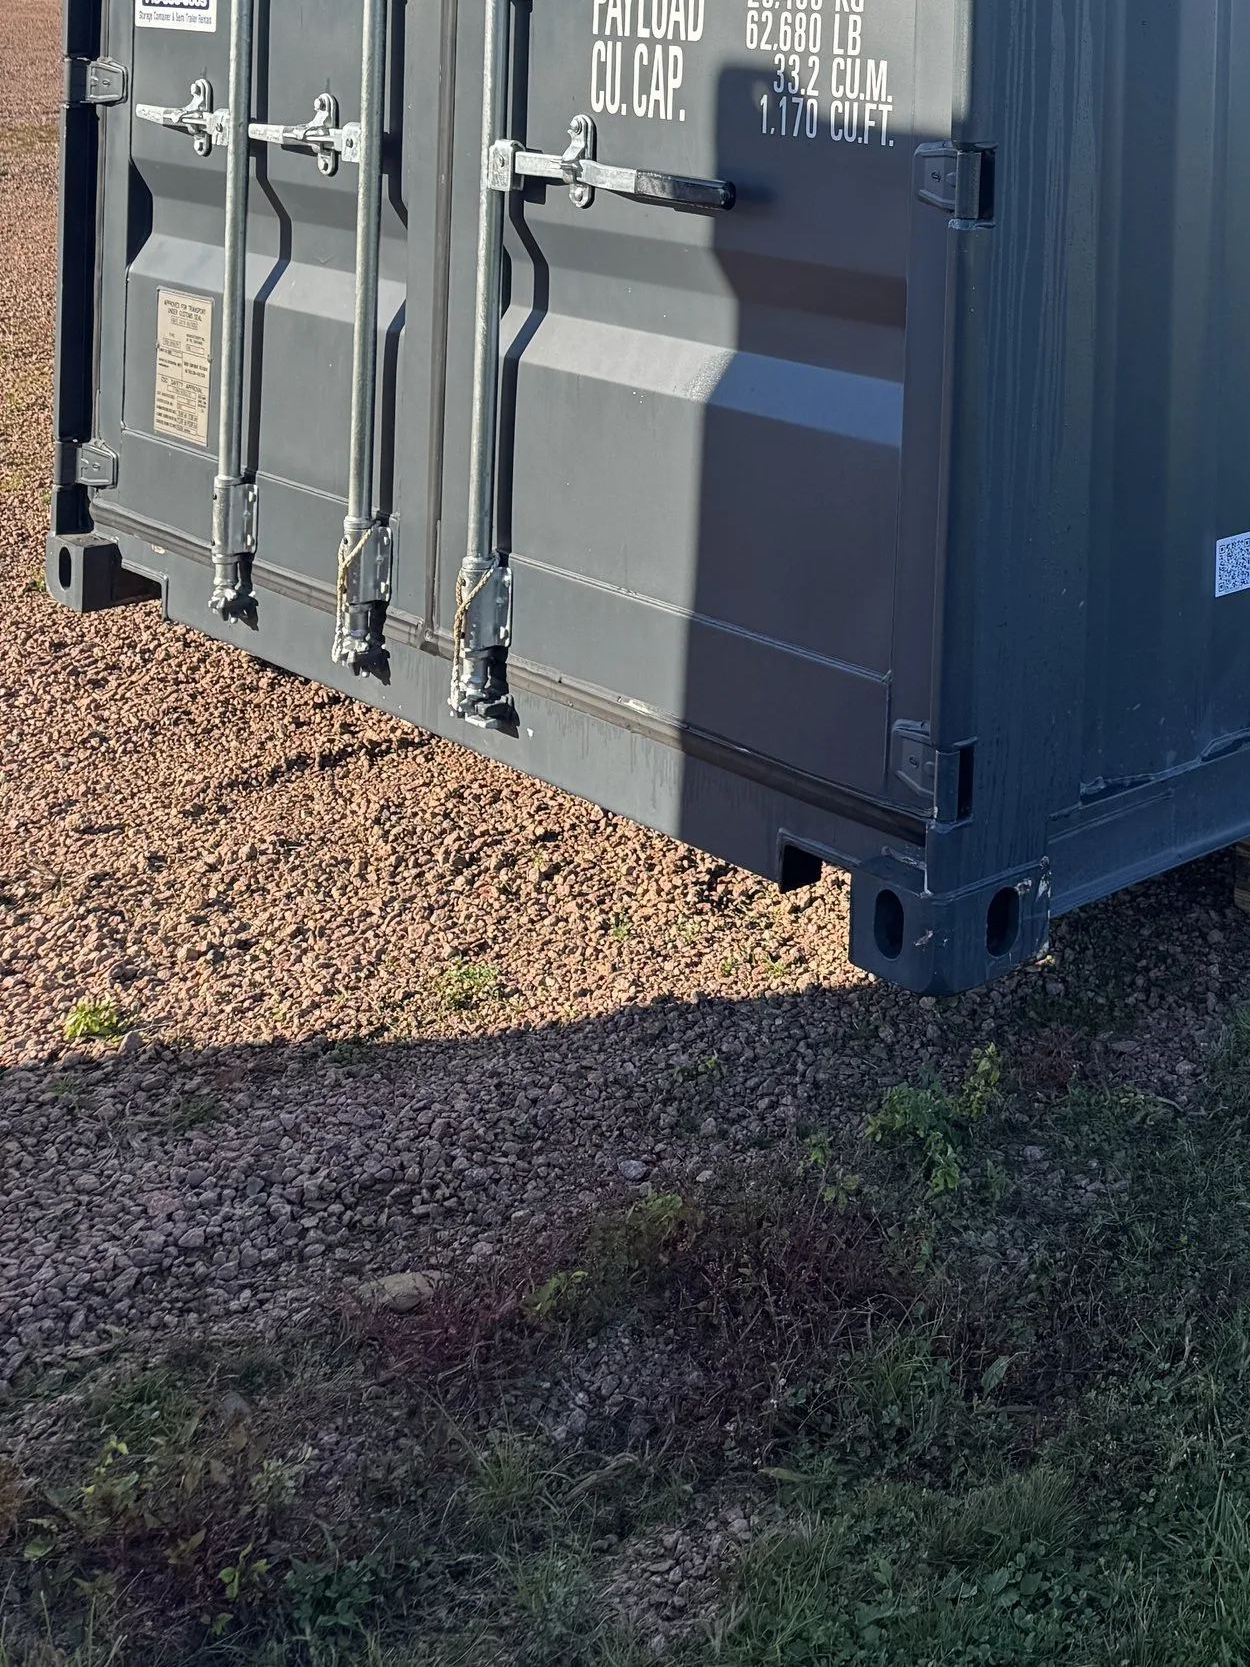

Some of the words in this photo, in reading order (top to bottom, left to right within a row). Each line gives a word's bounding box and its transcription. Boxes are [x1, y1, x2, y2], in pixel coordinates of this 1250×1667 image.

[745, 10, 822, 54] 62,680
[833, 13, 862, 56] LB
[590, 40, 627, 116] CU.
[632, 43, 686, 122] CAP.
[773, 53, 820, 97] 33.2
[830, 57, 893, 103] CU.M.
[760, 94, 819, 139] 1,170
